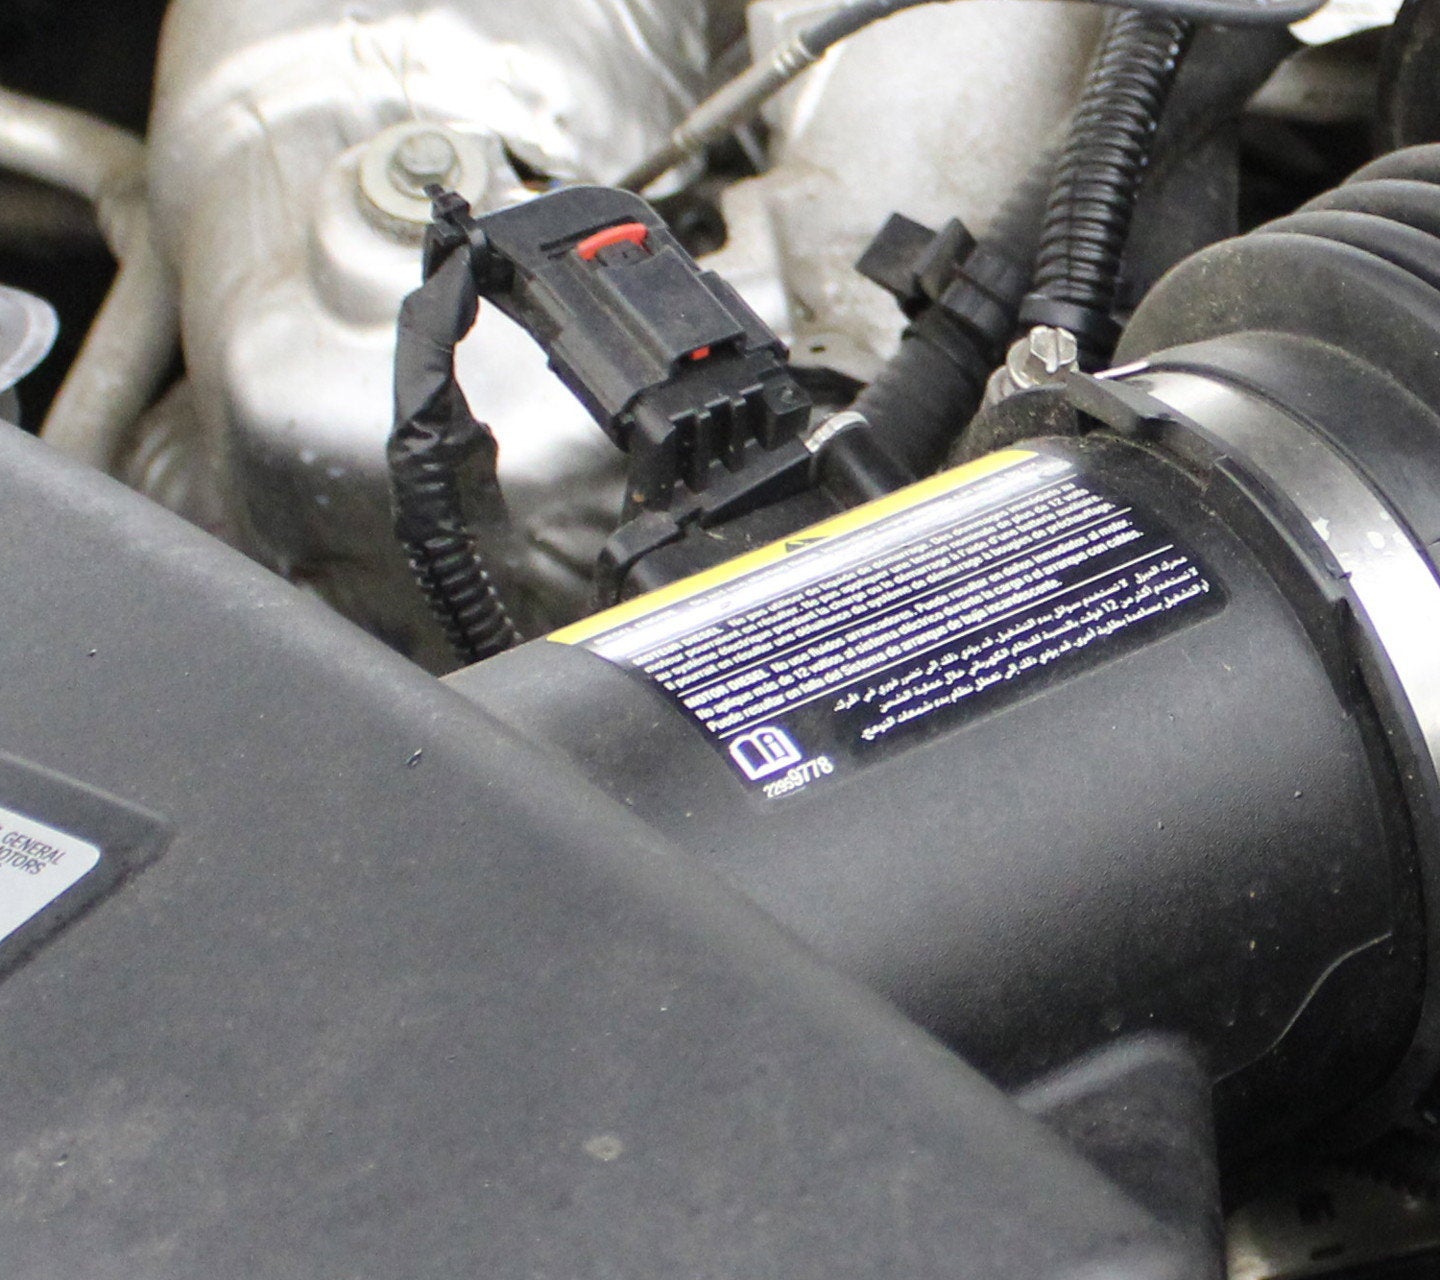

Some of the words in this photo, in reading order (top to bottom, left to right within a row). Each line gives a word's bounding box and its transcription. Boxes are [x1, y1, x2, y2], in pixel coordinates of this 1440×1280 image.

[683, 684, 730, 709] MOTOR
[726, 668, 771, 691] DIESEL
[787, 652, 811, 667] use
[914, 594, 950, 613] Puede
[751, 681, 780, 697] más
[942, 594, 984, 616] durante
[1042, 551, 1088, 575] arranque
[1085, 542, 1109, 557] con
[1106, 529, 1144, 549] cables.
[706, 711, 745, 732] Puede
[823, 669, 846, 684] del
[900, 625, 949, 651] arranque
[763, 756, 834, 795] 22959778
[2, 831, 65, 865] GENERAL
